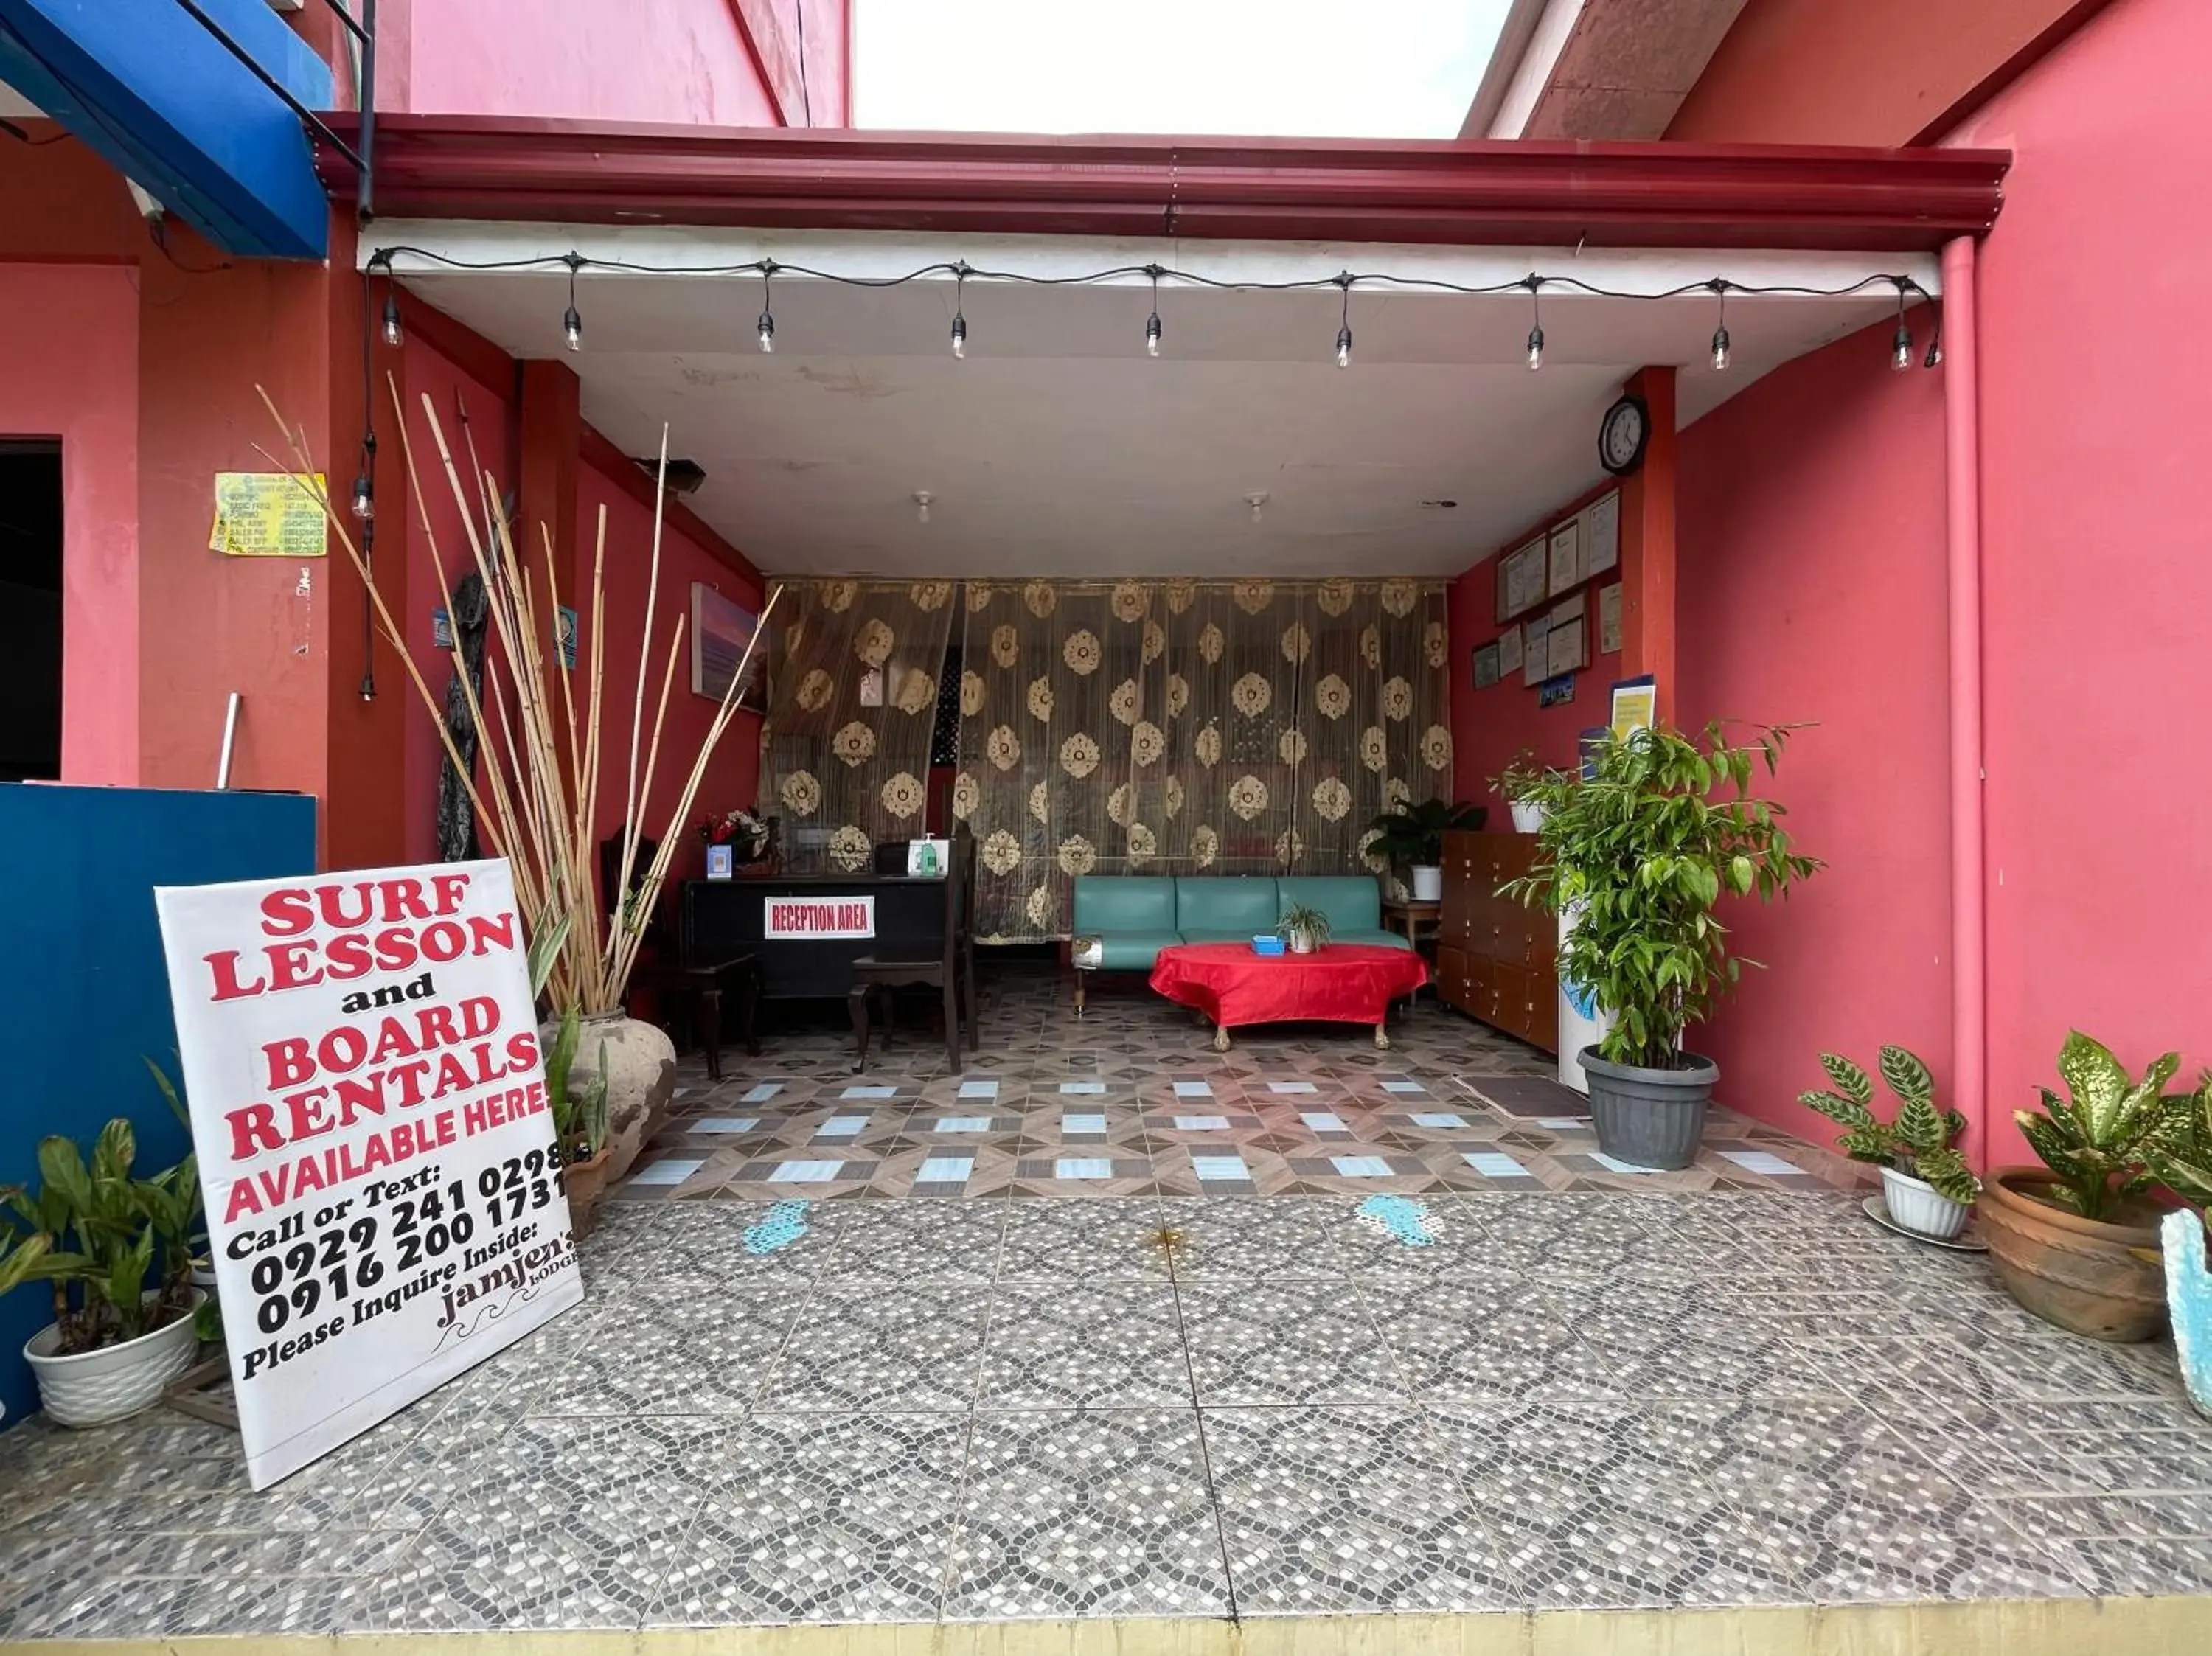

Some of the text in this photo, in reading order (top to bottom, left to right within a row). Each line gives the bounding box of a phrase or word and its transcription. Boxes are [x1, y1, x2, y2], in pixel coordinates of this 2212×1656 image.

[260, 874, 470, 936] SURF
[772, 903, 867, 932] RECEPTION AREA
[203, 913, 514, 1002] LESSON
[341, 972, 436, 1015] and
[262, 996, 501, 1091] BOARD
[225, 1032, 540, 1161] RENTALS
[224, 1110, 456, 1224] AVAILABLE
[226, 1164, 441, 1260] Call or Text:
[251, 1141, 563, 1295] 0929 241 0298
[257, 1171, 566, 1334] 0916 200 1731
[243, 1222, 538, 1381] Please Inquire Inside:
[437, 1230, 577, 1328] jamjen's
